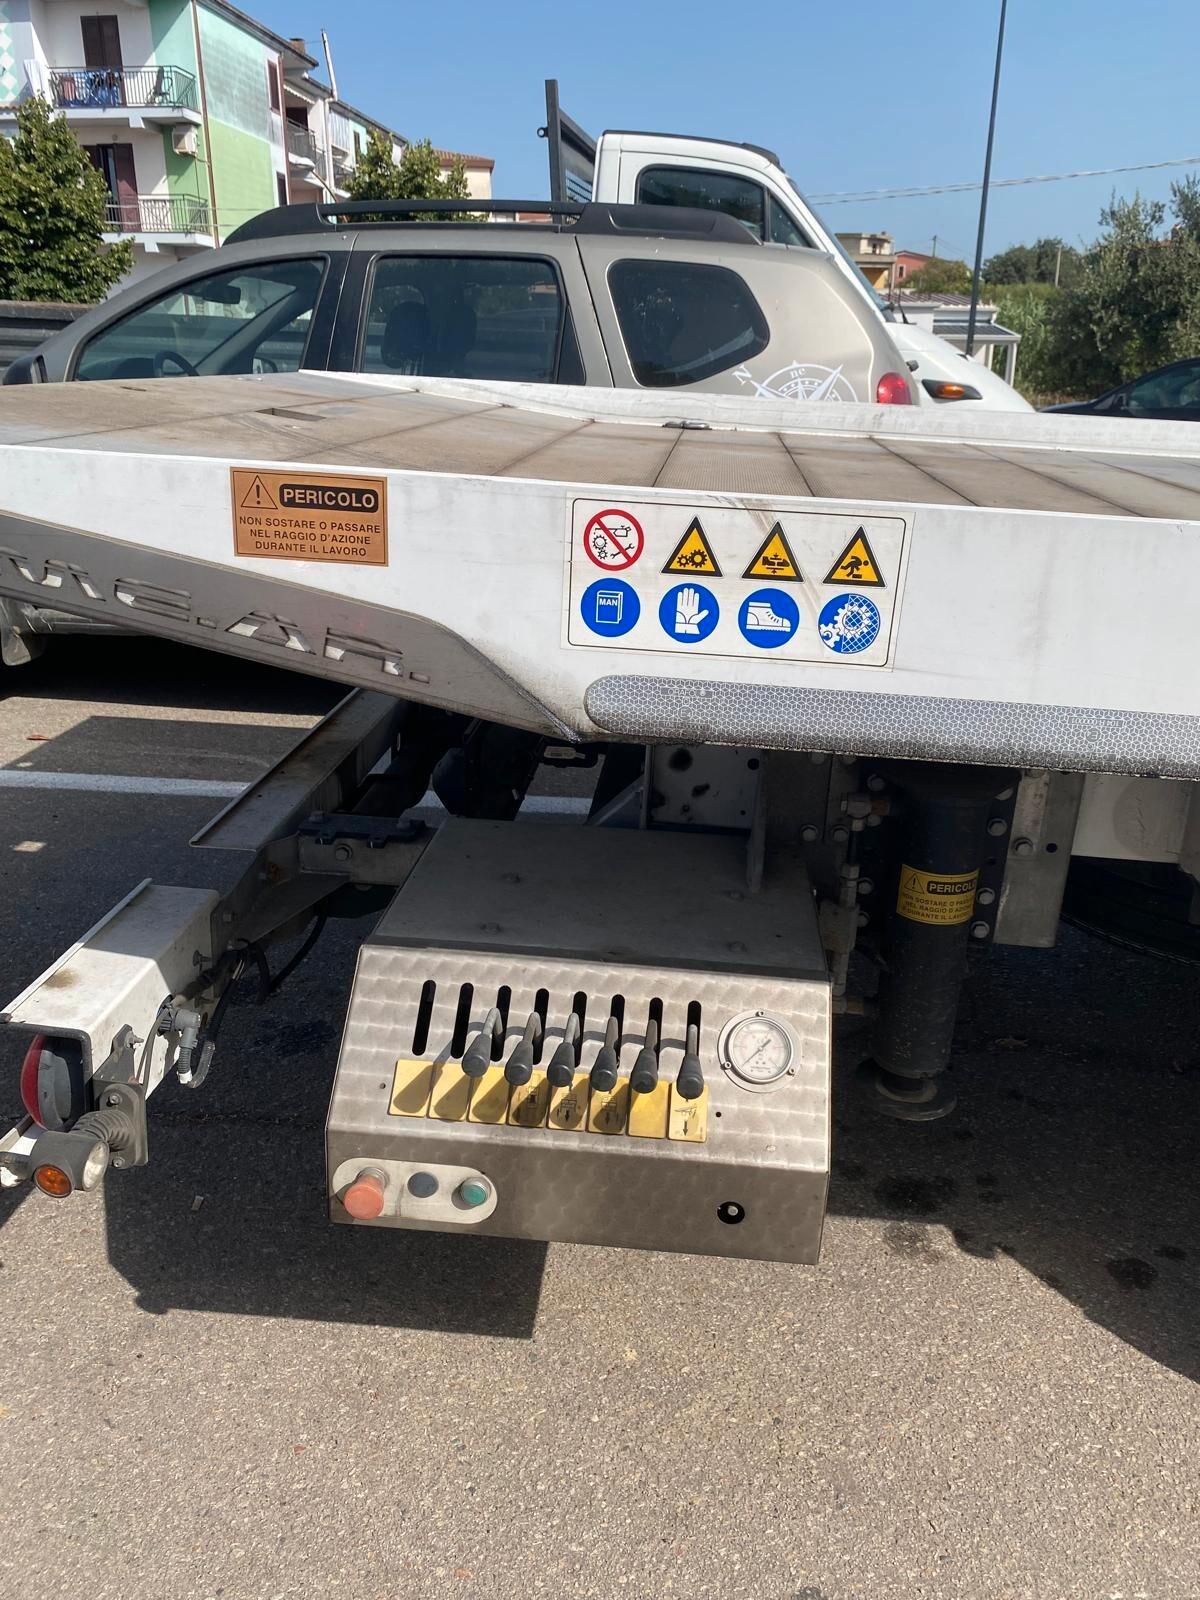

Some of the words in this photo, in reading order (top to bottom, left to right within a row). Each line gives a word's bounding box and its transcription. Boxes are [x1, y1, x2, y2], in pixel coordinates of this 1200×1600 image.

[731, 364, 752, 386] N
[283, 488, 375, 509] PERICOLO
[239, 516, 262, 526] NON
[265, 517, 316, 530] SOSTARE
[319, 521, 327, 530] O
[330, 522, 381, 534] PASSARE
[250, 528, 271, 538] NEL
[273, 530, 317, 542] RAGGIO
[320, 532, 371, 545] D'AZIONE
[255, 540, 306, 553] DURANTE
[309, 543, 319, 554] IL
[322, 546, 367, 557] LAVORO
[599, 598, 618, 606] MAN
